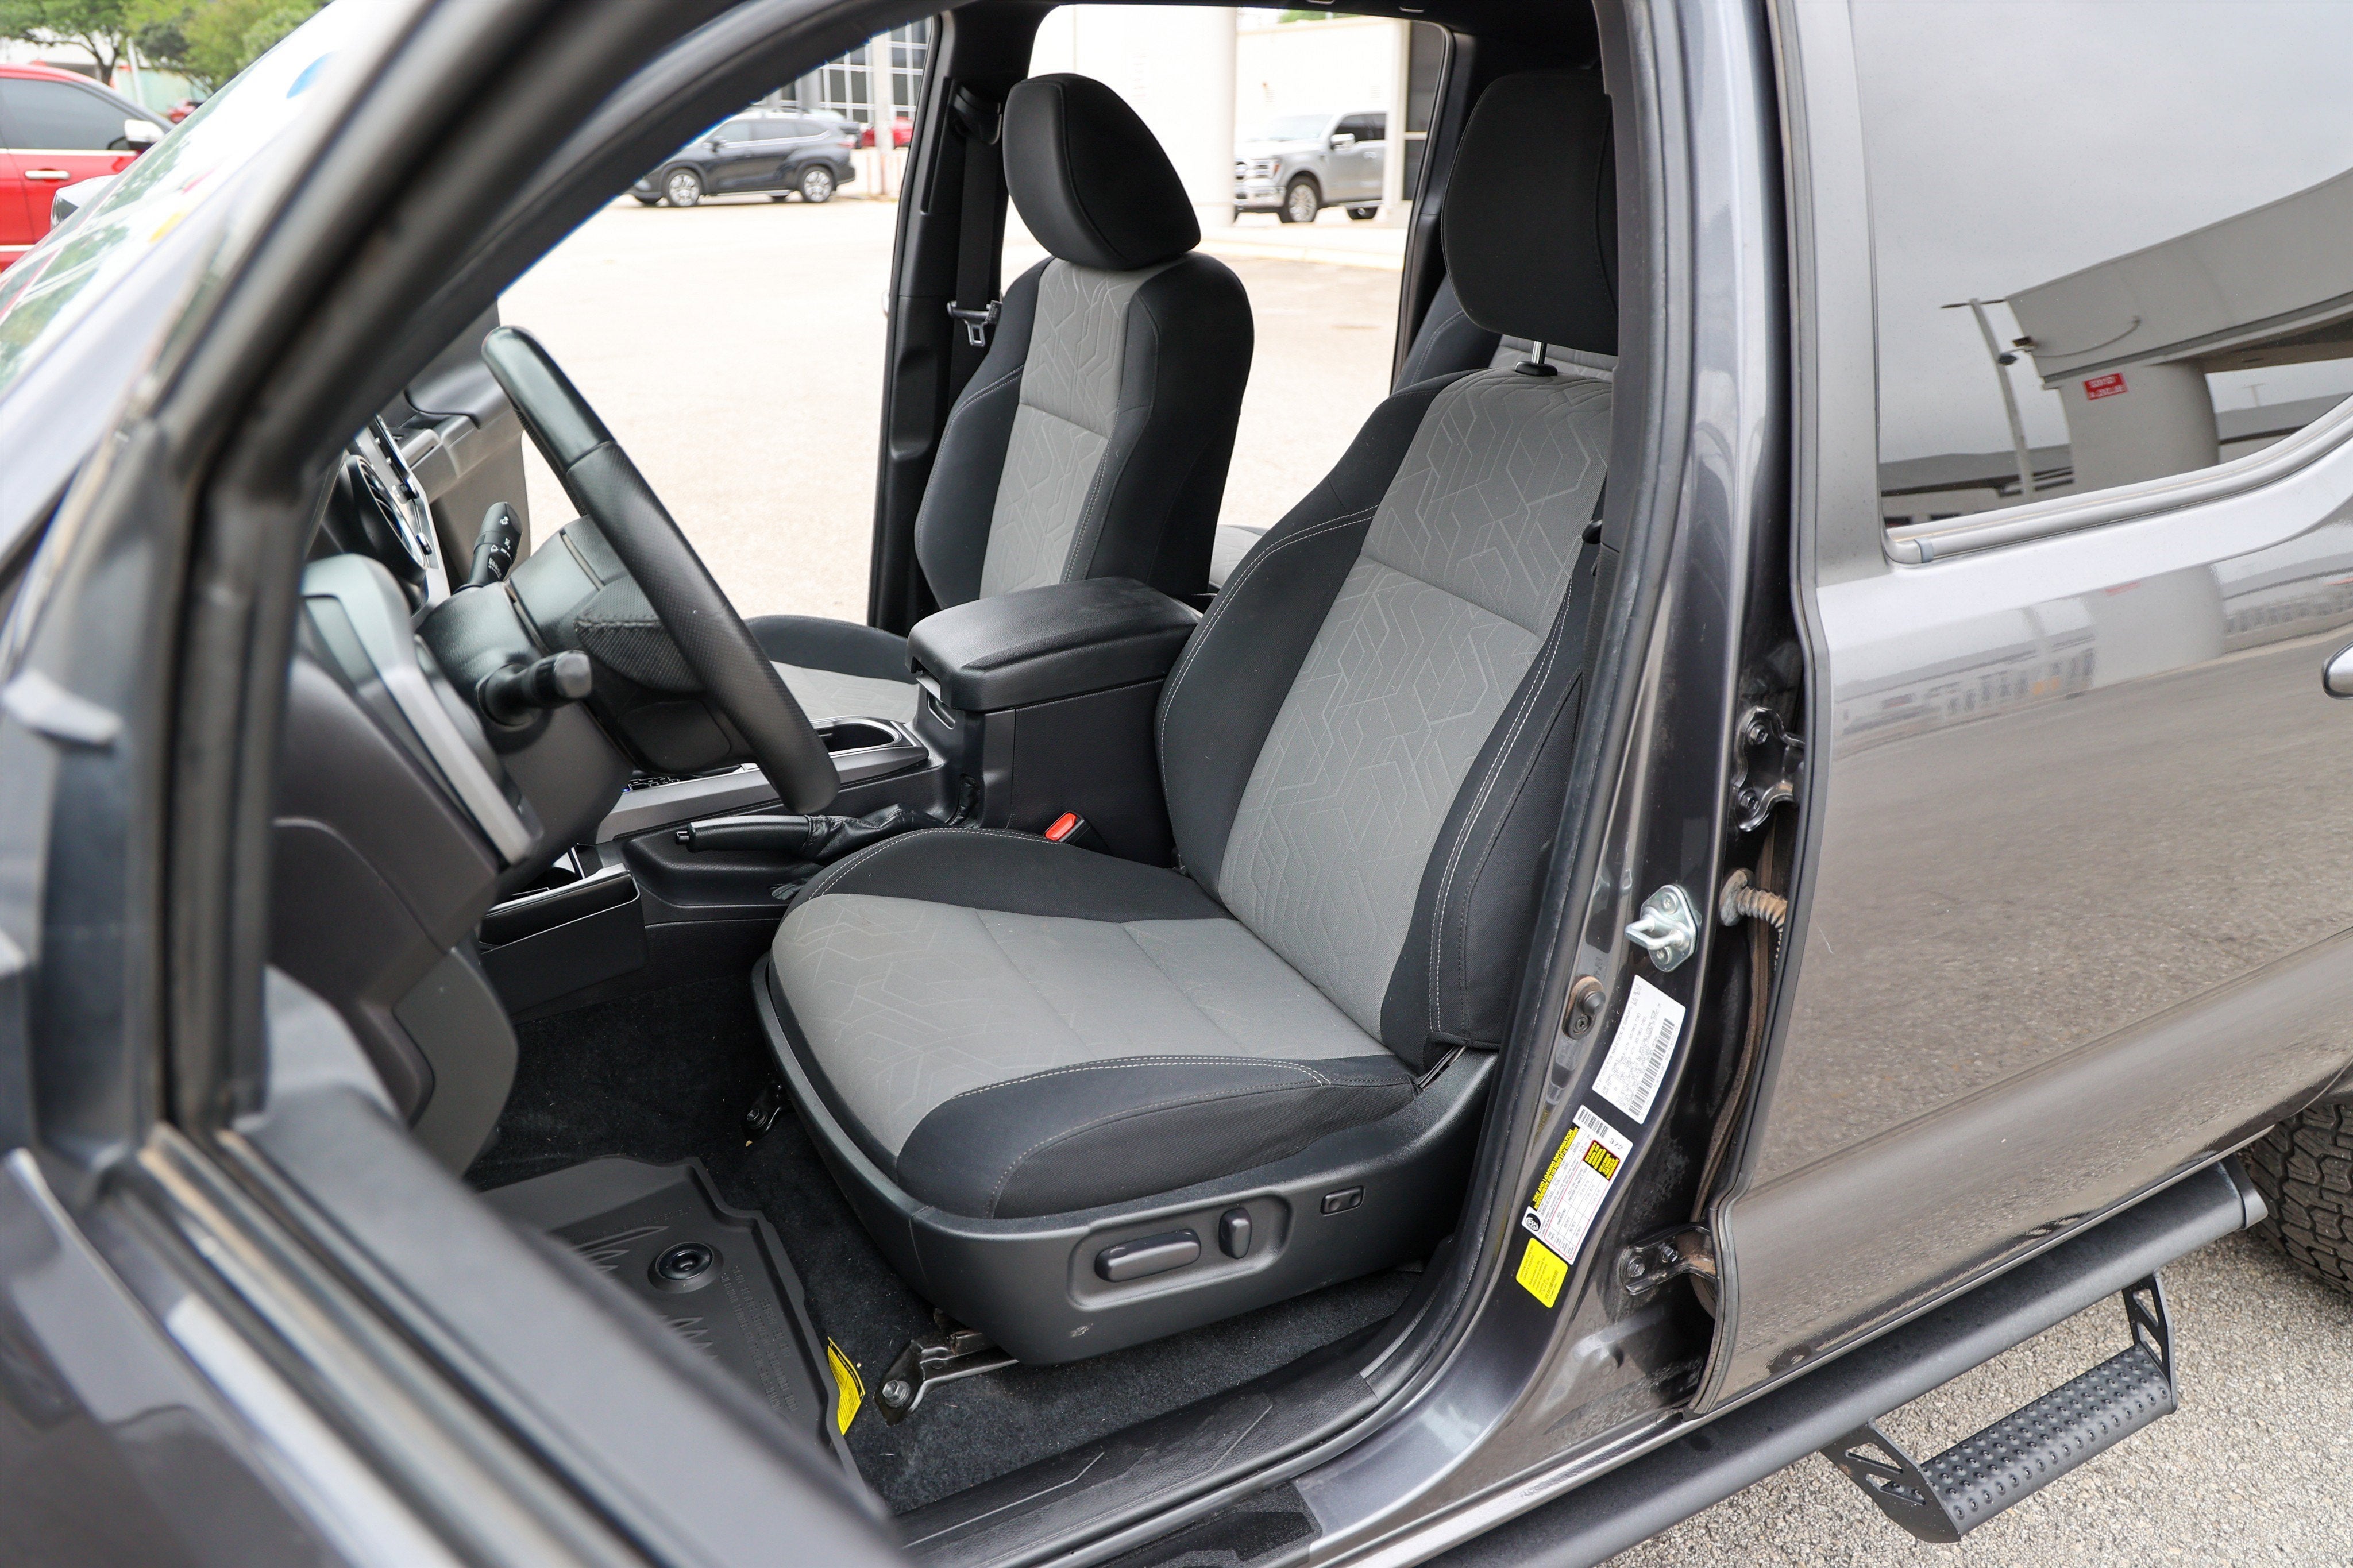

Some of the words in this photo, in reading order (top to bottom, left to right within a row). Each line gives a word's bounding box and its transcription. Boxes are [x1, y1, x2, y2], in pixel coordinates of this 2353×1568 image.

[1532, 1191, 1540, 1203] TIRE
[1537, 1180, 1545, 1192] AND
[1542, 1160, 1556, 1183] LOADING
[1553, 1128, 1573, 1162] INFORMATION
[1608, 1137, 1623, 1150] 372
